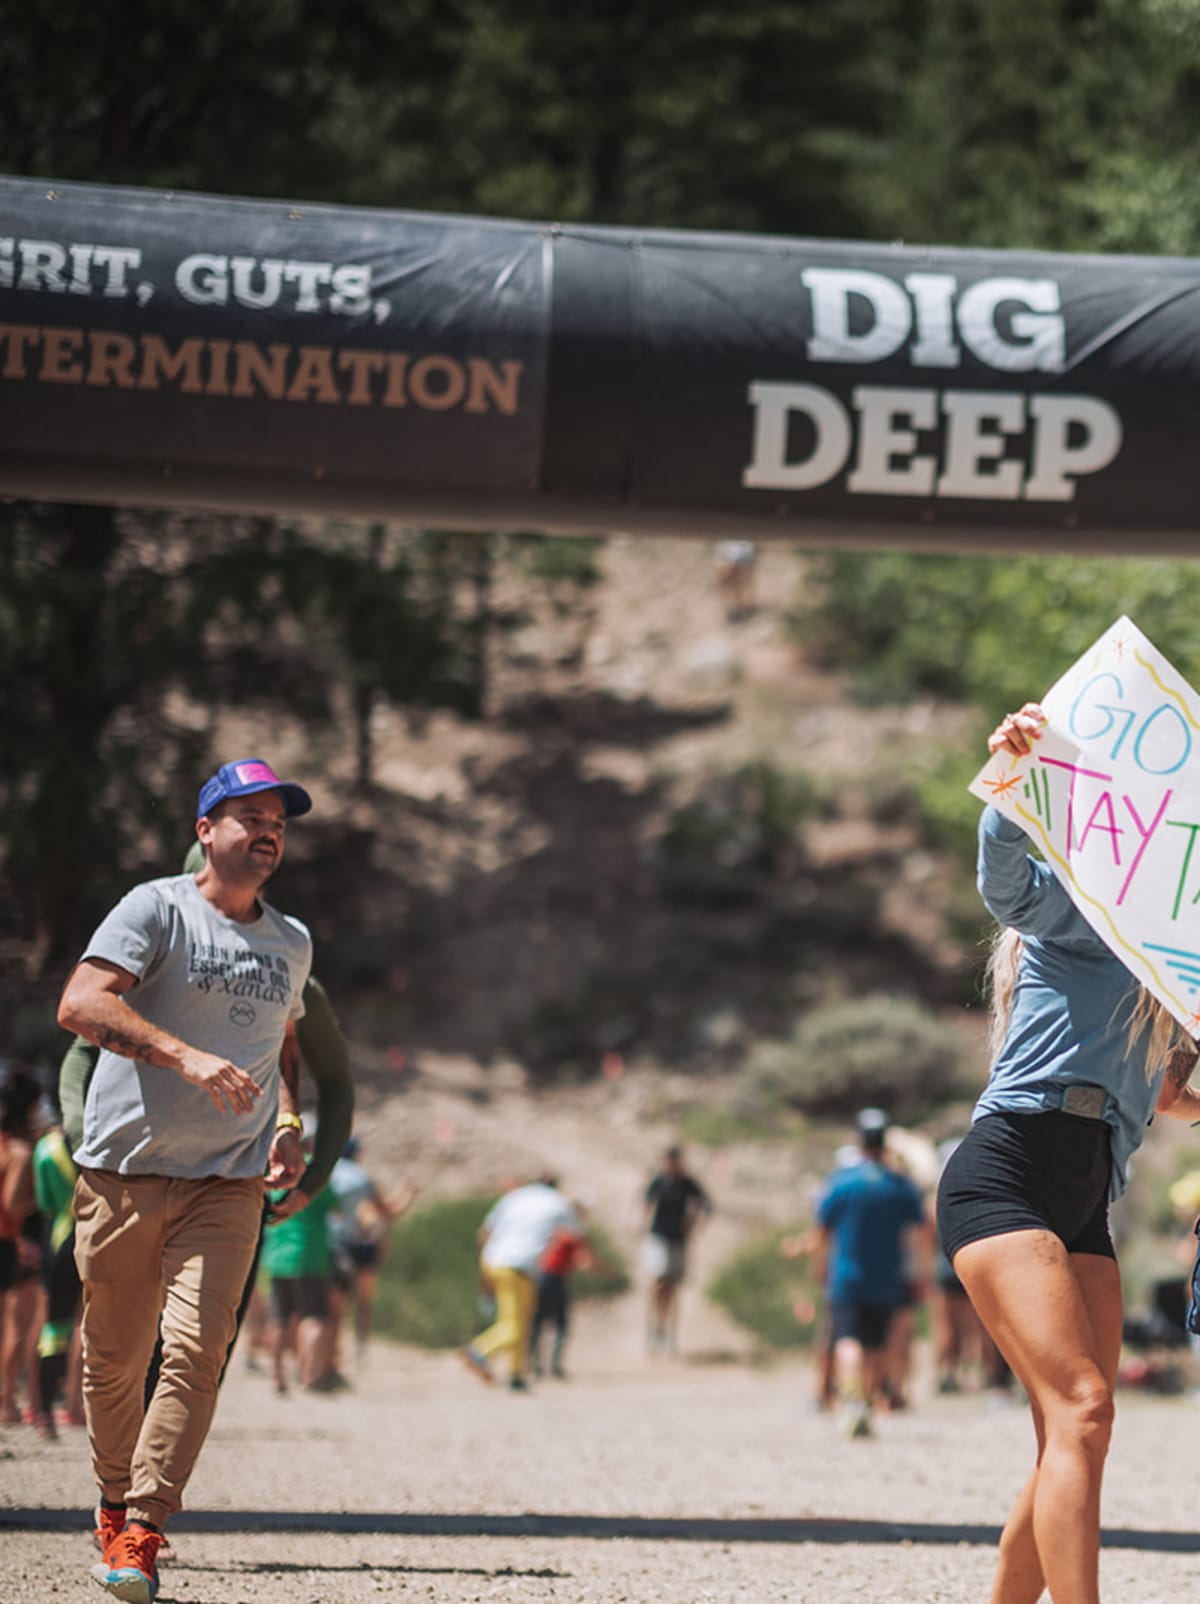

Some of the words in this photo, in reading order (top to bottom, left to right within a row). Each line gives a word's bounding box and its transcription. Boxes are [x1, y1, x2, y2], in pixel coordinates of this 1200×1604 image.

[0, 236, 154, 308] RIT,
[174, 252, 392, 326] GUTS,
[800, 267, 1067, 375] DIG
[0, 322, 524, 416] TERMINATION
[742, 379, 1123, 503] DEEP
[1069, 672, 1192, 776] GO
[1038, 755, 1174, 907] TAY
